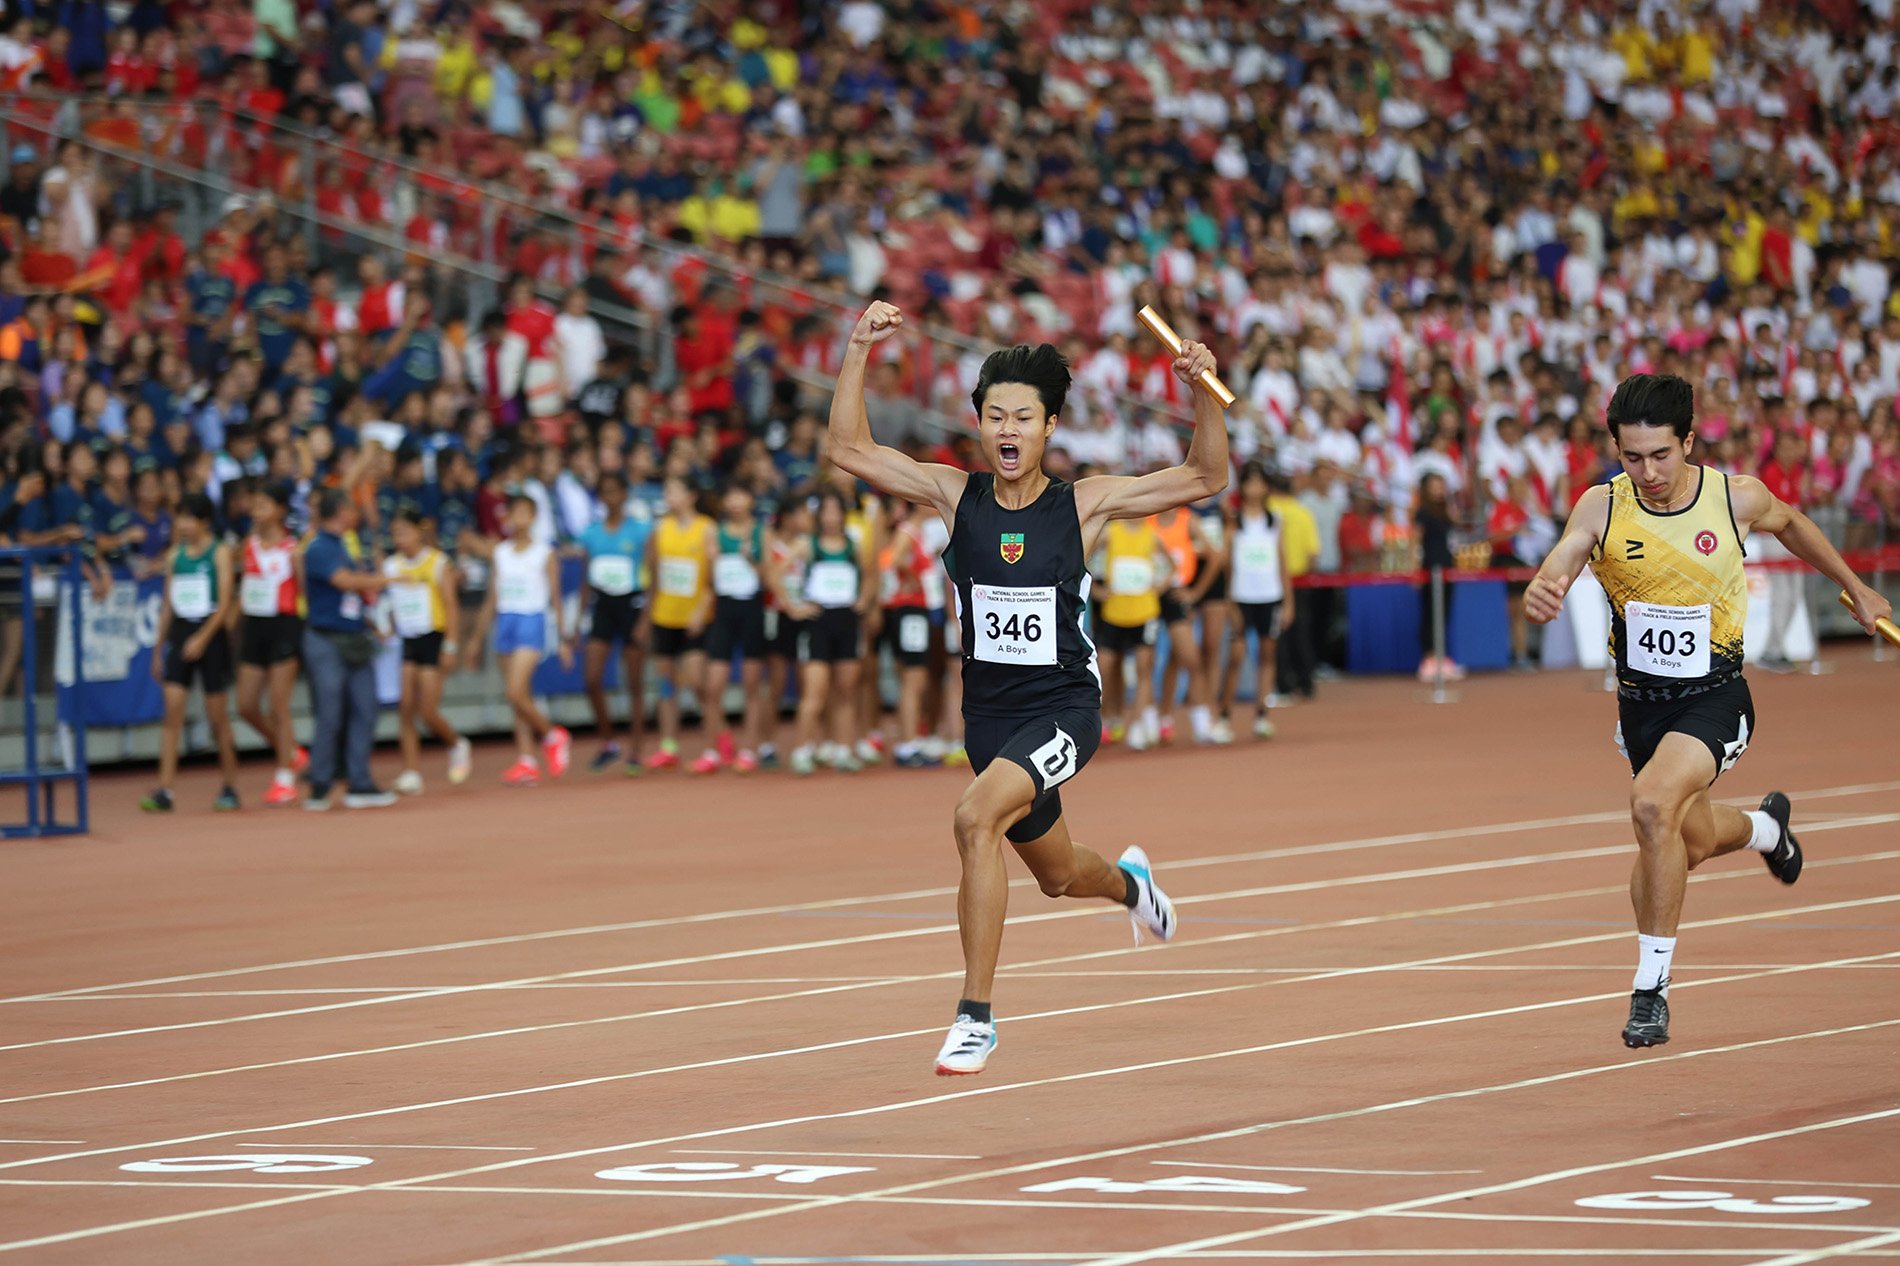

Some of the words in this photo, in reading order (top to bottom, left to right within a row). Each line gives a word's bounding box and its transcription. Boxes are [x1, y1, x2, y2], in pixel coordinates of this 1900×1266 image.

[985, 612, 1042, 642] 346
[1006, 645, 1027, 655] Boys
[1638, 628, 1696, 657] 403
[1652, 657, 1658, 665] A
[1660, 658, 1682, 668] Boys
[1043, 737, 1074, 777] 5
[593, 1162, 879, 1183] 5
[1017, 1175, 1308, 1194] 4
[1574, 1190, 1872, 1213] 3
